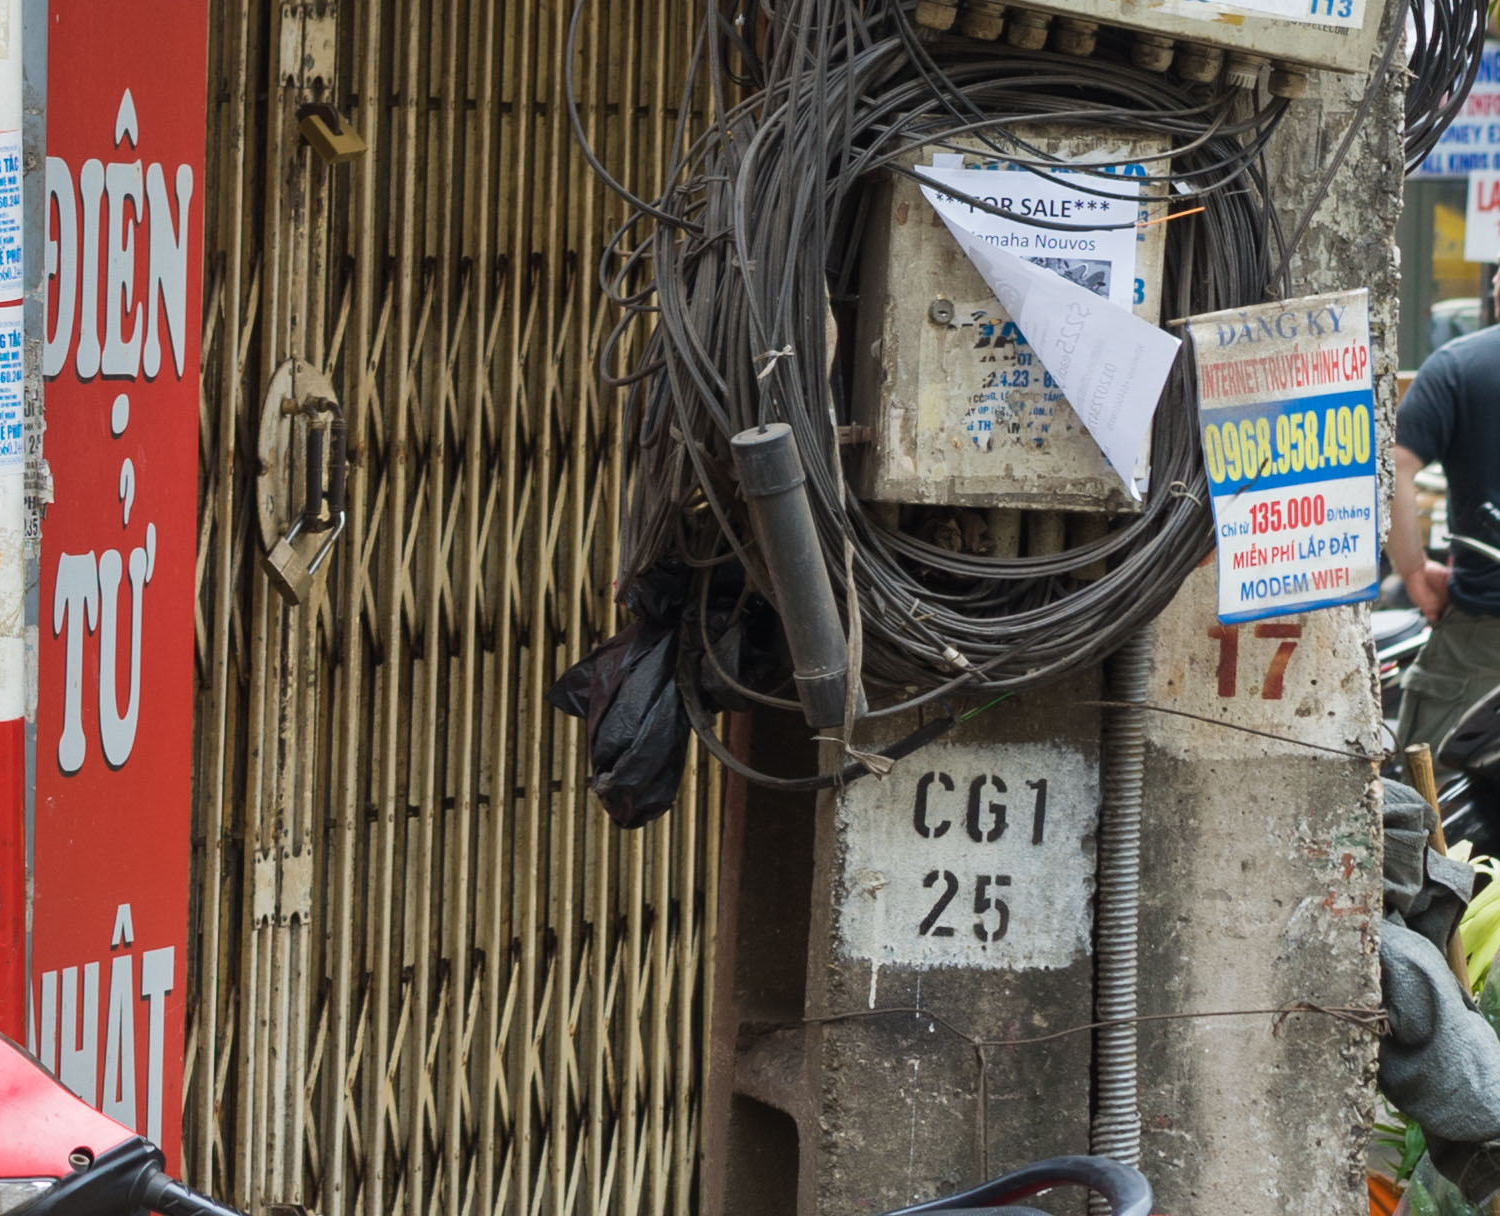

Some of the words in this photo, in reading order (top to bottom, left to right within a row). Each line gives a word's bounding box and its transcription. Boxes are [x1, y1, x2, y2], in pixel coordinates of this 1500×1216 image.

[1035, 233, 1096, 252] Nouvos
[1216, 311, 1299, 347] ĐĂNG
[1201, 357, 1261, 400] INTERNET
[1260, 343, 1309, 393] TRUYỀN
[1311, 344, 1340, 386] HÌNH
[1342, 338, 1367, 382] CÁP
[1204, 403, 1371, 484] 0968.958.490
[1249, 494, 1325, 535] 135.000
[1232, 543, 1268, 570] MIỄN
[1271, 539, 1295, 565] PHÍ
[1329, 533, 1360, 559] ĐẶT
[1240, 572, 1309, 601] MODEM
[1311, 567, 1350, 591] WIFI
[1207, 623, 1303, 700] 17
[913, 771, 1048, 845] CG1
[919, 869, 1012, 943] 25
